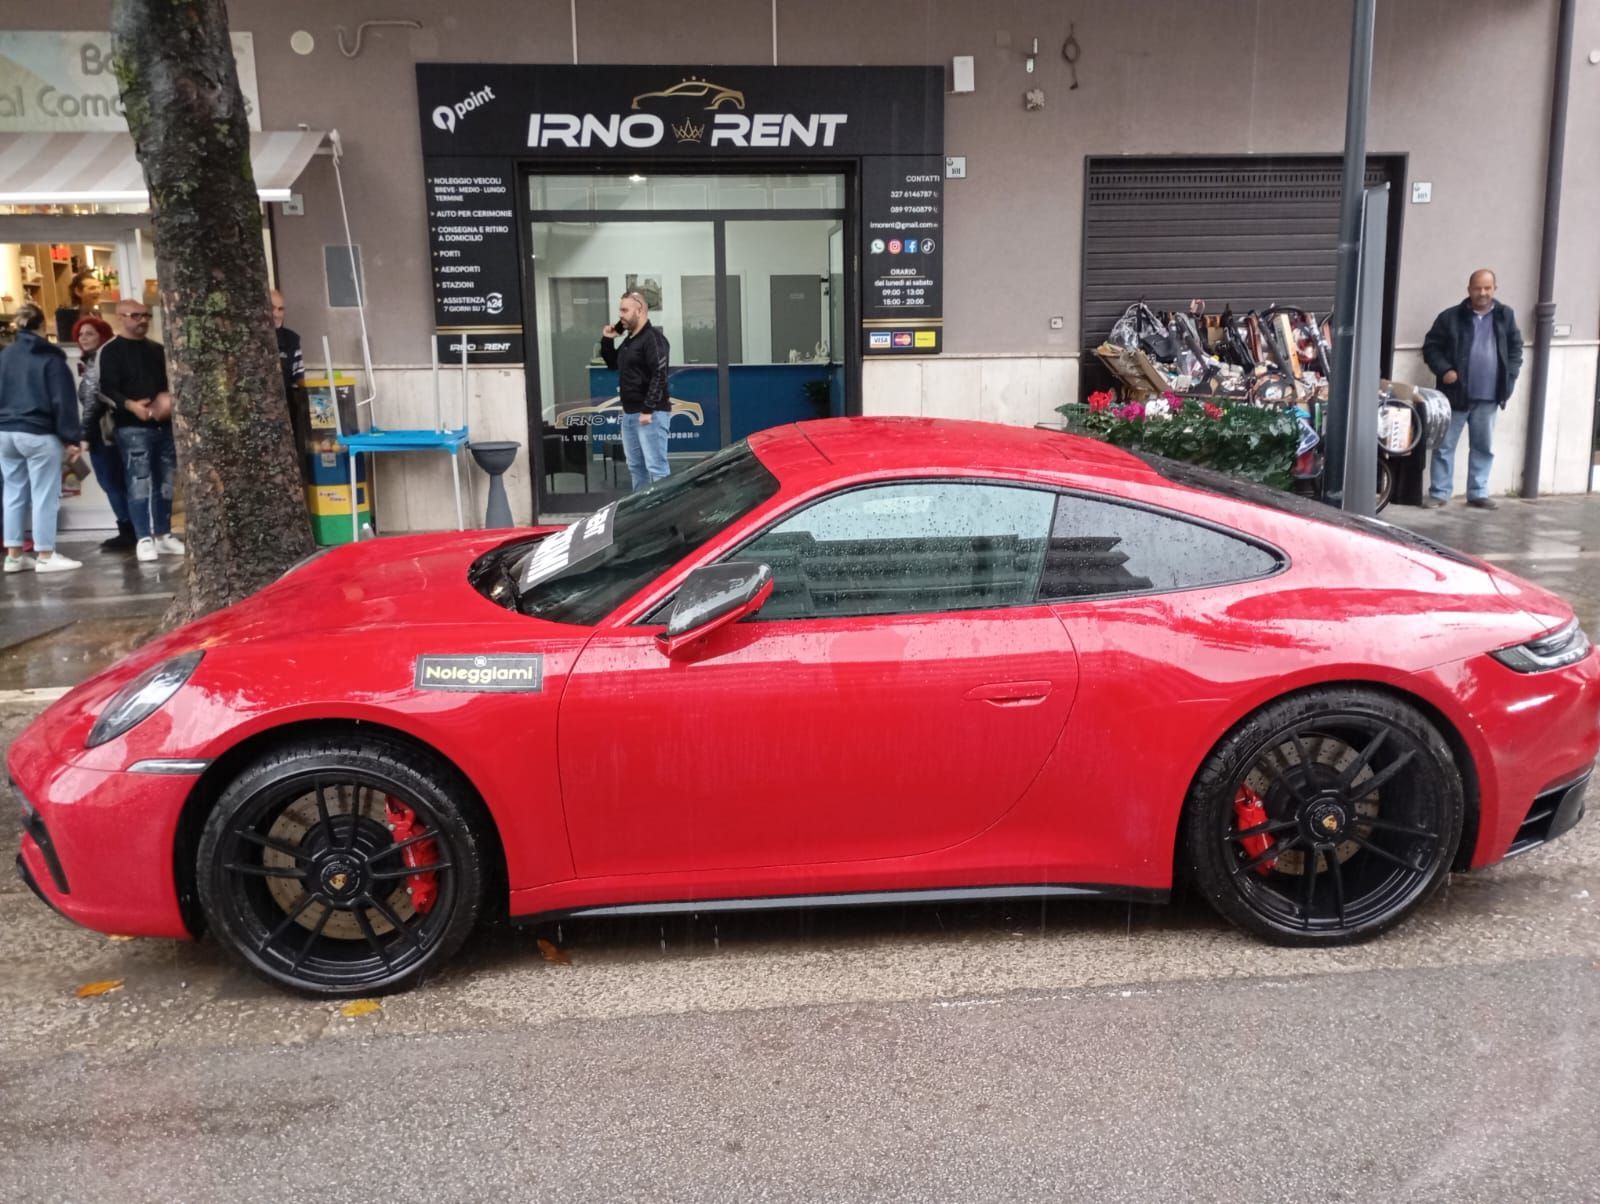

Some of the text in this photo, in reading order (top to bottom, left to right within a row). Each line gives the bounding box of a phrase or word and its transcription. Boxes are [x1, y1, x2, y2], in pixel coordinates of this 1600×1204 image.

[454, 85, 496, 120] point
[527, 113, 848, 148] IRNO RENT
[433, 177, 502, 185] NOLEGGIO VEICOLI
[435, 194, 464, 202] TERMINE
[890, 190, 903, 198] 327
[439, 250, 461, 258] PORTI
[890, 268, 917, 276] ORARIO
[441, 281, 475, 289] STAZIONI
[912, 279, 934, 287] sabato
[906, 288, 925, 296] 13:00
[443, 296, 485, 304] ASSISTENZA
[483, 343, 511, 351] RENT
[566, 415, 606, 427] IRNO
[572, 434, 589, 442] TUO
[425, 665, 533, 684] Noleggiami
